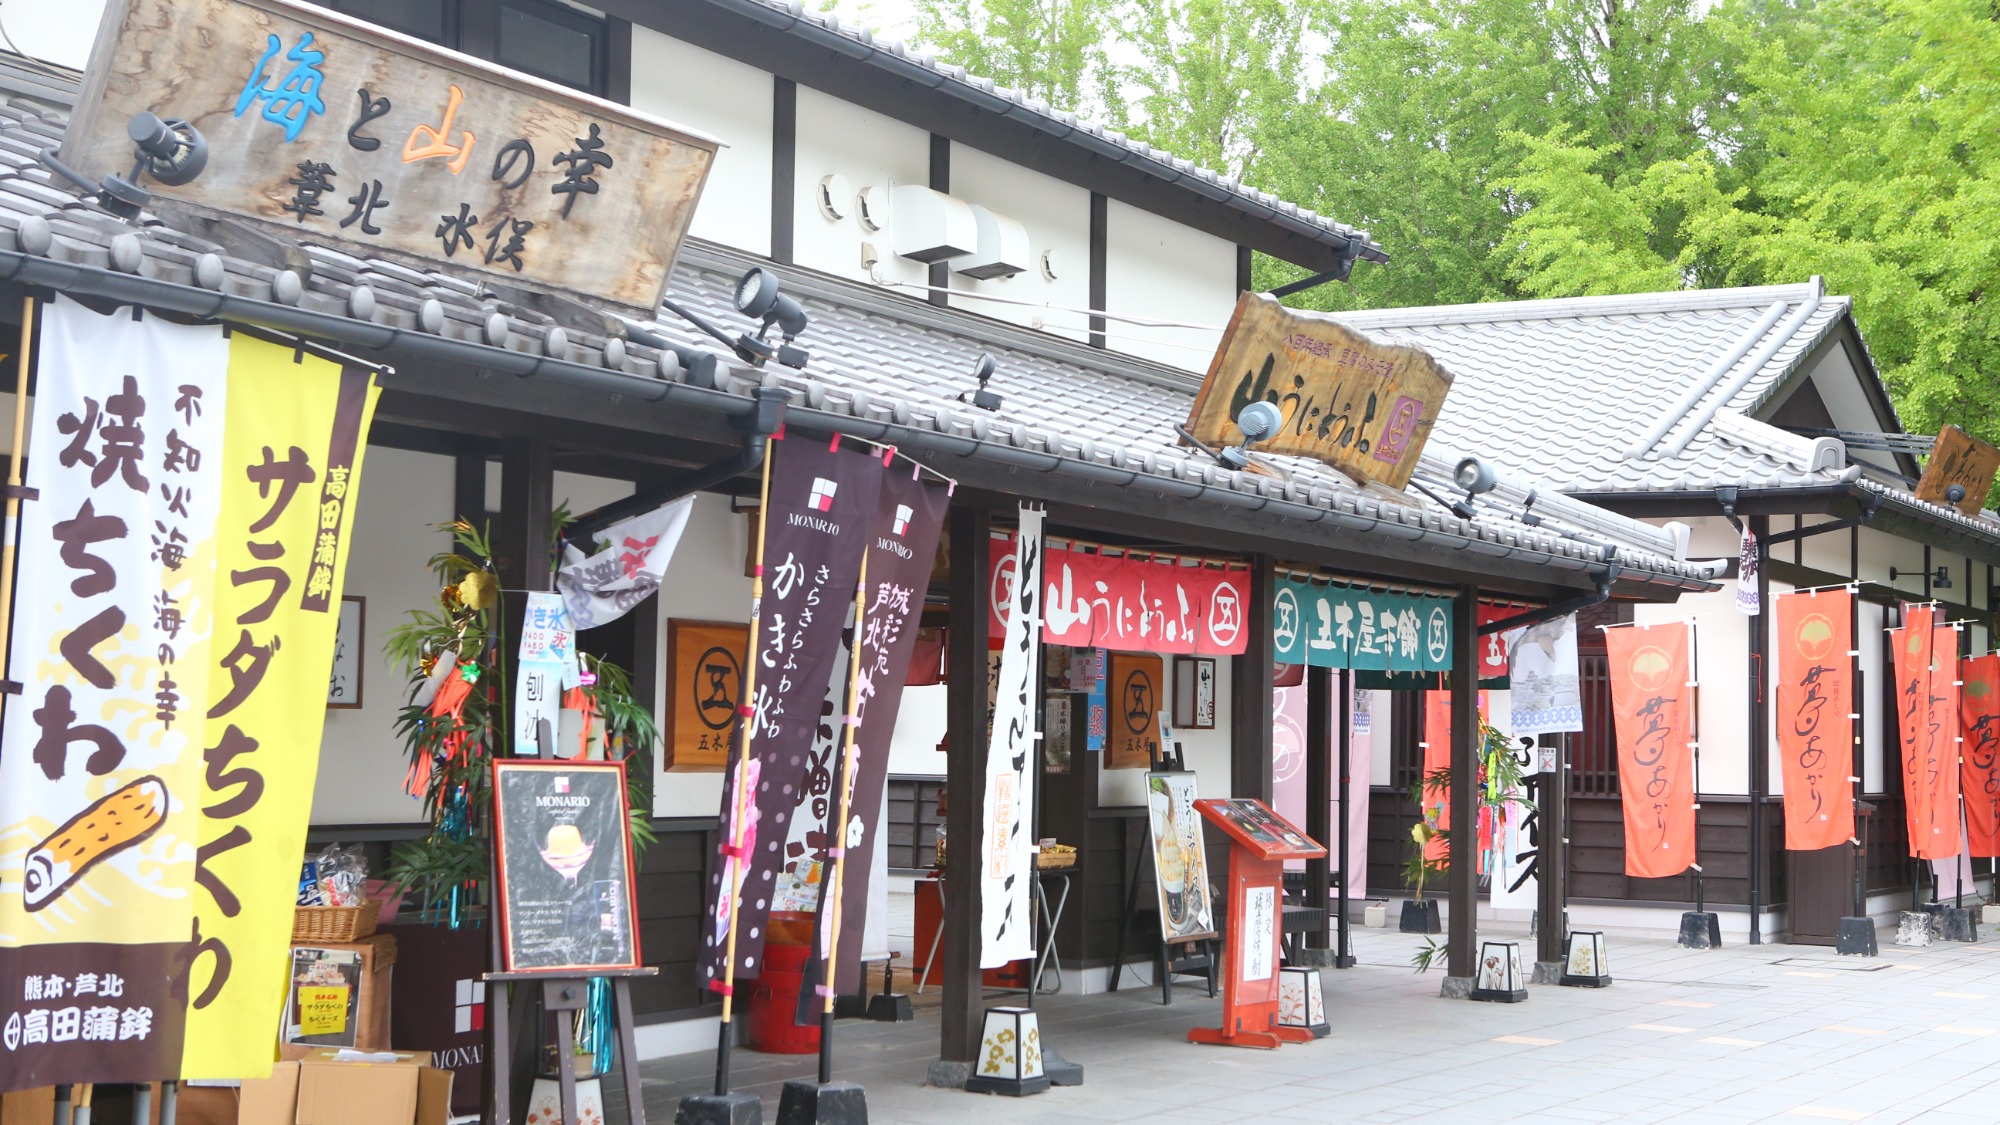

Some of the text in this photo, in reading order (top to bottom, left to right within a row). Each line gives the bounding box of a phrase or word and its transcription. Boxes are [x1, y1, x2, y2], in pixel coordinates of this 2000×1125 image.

[234, 31, 613, 220] 海と山の幸
[436, 203, 534, 272] 水俣
[31, 374, 151, 782] 焼ちくわ
[306, 464, 351, 601] 高田蒲鉾
[786, 512, 840, 537] MONARIO
[1309, 597, 1422, 661] 五木屋本舗
[191, 445, 317, 1010] サラダちくわ
[1633, 695, 1678, 852] 夢あかり
[1794, 664, 1837, 824] 夢あかり
[535, 796, 591, 808] MONARIO
[22, 1005, 153, 1046] 高田蒲鉾
